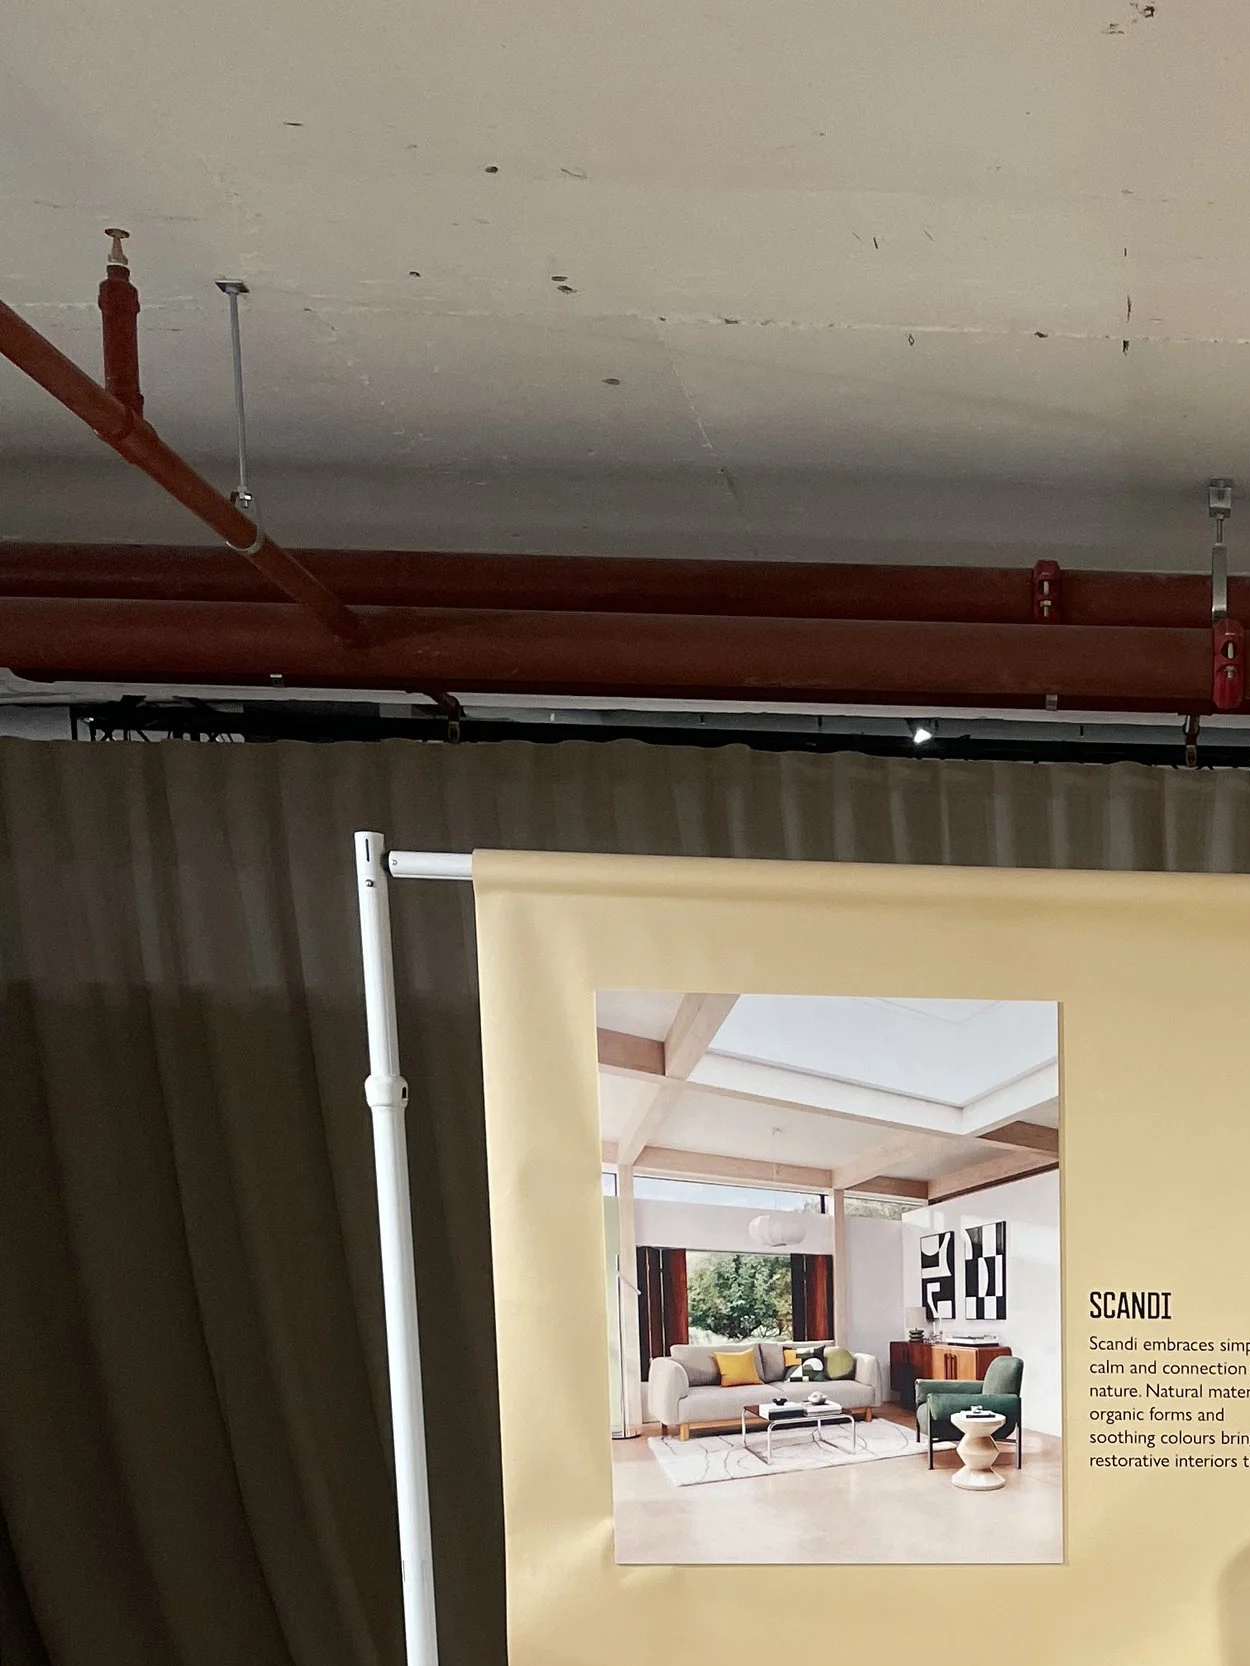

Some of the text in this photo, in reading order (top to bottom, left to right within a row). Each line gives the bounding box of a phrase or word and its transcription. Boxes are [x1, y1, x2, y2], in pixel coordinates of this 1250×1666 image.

[1089, 1291, 1172, 1320] SCANDI
[1089, 1335, 1138, 1351] Scandi
[1143, 1336, 1215, 1352] embraces
[1089, 1359, 1125, 1374] calm
[1129, 1360, 1157, 1375] and
[1162, 1361, 1247, 1376] connection
[1089, 1384, 1143, 1398] nature.
[1145, 1383, 1203, 1399] Natural
[1089, 1406, 1225, 1425] organic forms and
[1089, 1430, 1156, 1449] soothing
[1160, 1430, 1216, 1445] colours
[1089, 1453, 1170, 1468] restorative
[1175, 1453, 1238, 1468] interiors
